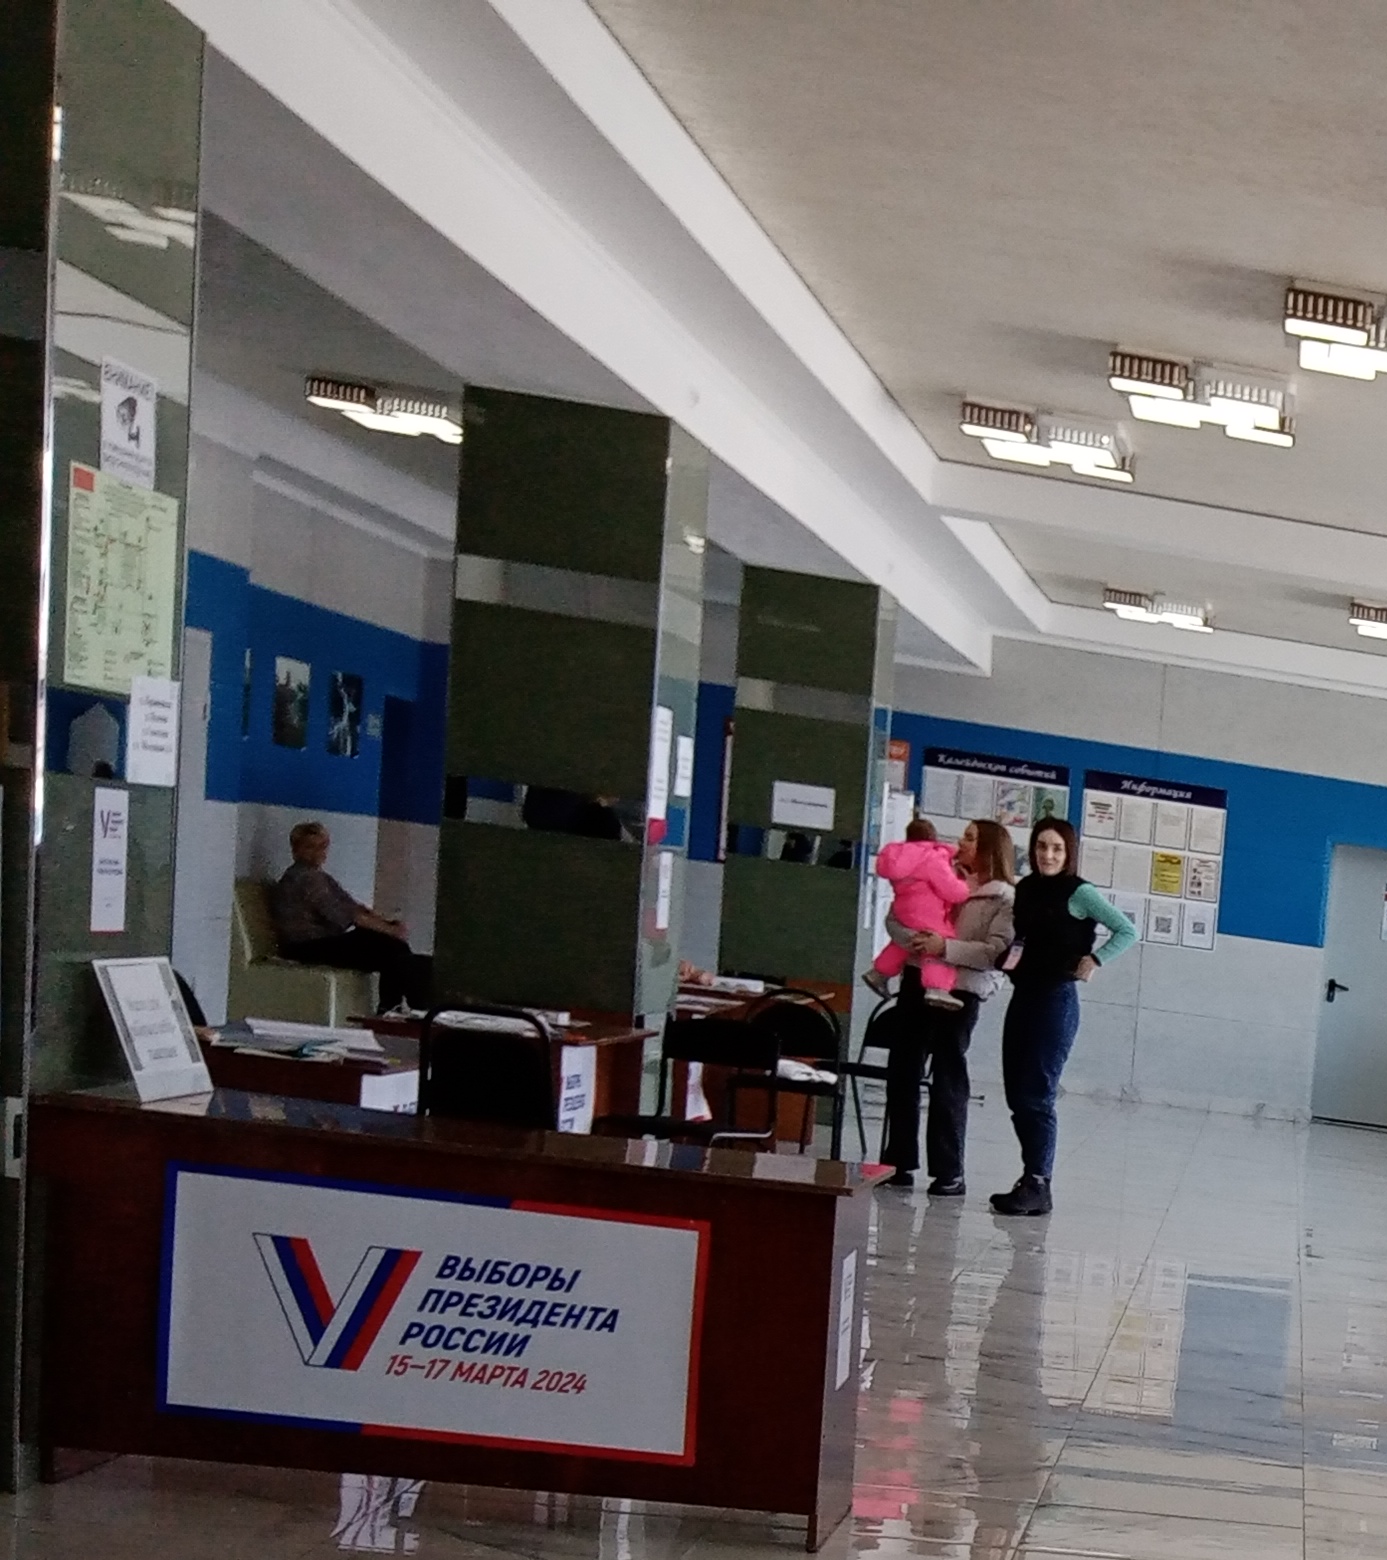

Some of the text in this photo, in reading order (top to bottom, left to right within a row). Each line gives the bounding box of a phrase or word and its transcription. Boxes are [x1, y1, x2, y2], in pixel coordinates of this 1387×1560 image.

[1008, 763, 1057, 781] событий
[1120, 780, 1193, 801] Информация
[435, 1254, 581, 1293] ВЫБОРЫ
[417, 1288, 620, 1333] ПРЕЗИДЕНТА
[399, 1321, 532, 1358] РОССИИ
[448, 1361, 530, 1389] МАРТА
[531, 1369, 588, 1395] 2024
